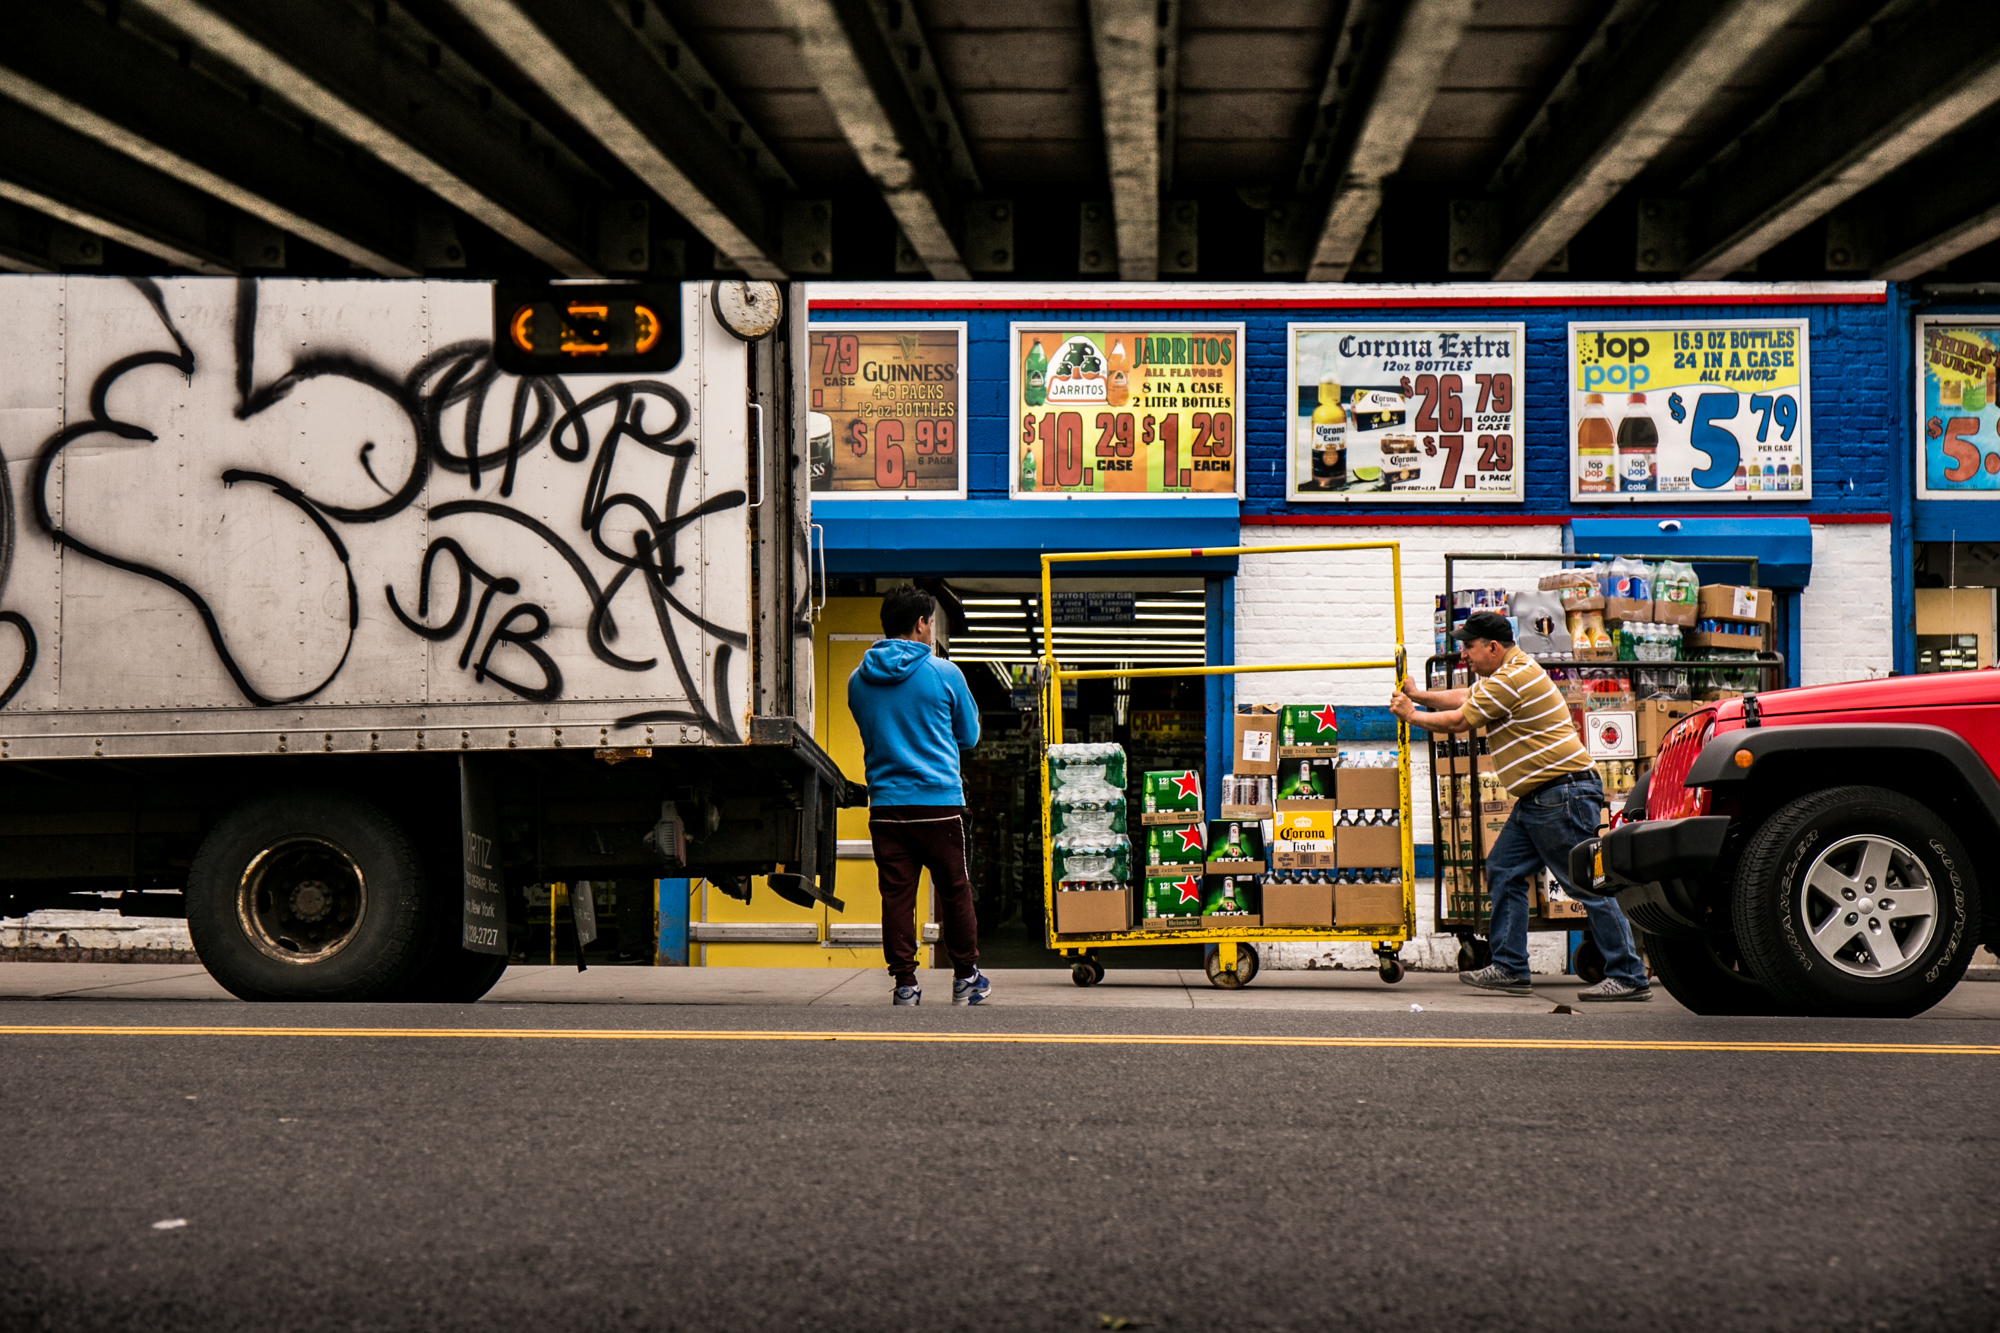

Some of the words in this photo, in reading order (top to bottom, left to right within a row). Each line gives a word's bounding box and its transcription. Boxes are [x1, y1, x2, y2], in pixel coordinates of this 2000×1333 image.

[1339, 335, 1432, 358] Corona
[1439, 333, 1510, 358] Extra
[1674, 332, 1703, 350] 16.9
[1708, 332, 1725, 349] OZ
[1730, 330, 1794, 349] BOTTLES
[1133, 338, 1232, 368] JARRITOS
[1595, 332, 1649, 363] top
[1415, 360, 1473, 371] BOTTLES
[1674, 352, 1696, 368] 24
[1704, 352, 1722, 368] IN
[1730, 352, 1741, 367] A
[1747, 351, 1794, 367] CASE
[1930, 349, 1986, 379] BURST
[862, 362, 954, 382] GUINNESS
[1144, 368, 1166, 377] ALL
[1170, 368, 1223, 377] FLAVORS
[1584, 364, 1650, 391] pop
[1700, 370, 1720, 381] ALL
[1725, 369, 1777, 381] FLAVORS
[824, 378, 855, 386] CASE
[1142, 382, 1151, 393] 8
[1157, 382, 1170, 393] IN
[1176, 382, 1185, 393] A
[1191, 382, 1223, 393] CASE
[872, 384, 896, 400] 4-6
[900, 384, 944, 400] PACKS
[1052, 384, 1104, 395] JARRITOS
[1133, 397, 1140, 407] 2
[1145, 397, 1177, 408] LITER
[1182, 397, 1230, 408] BOTTLES
[858, 402, 873, 418] 12
[878, 406, 890, 417] oz
[896, 402, 954, 418] BOTTLES
[1316, 426, 1345, 436] Corona
[918, 457, 924, 465] 6
[928, 456, 953, 465] PACK
[1096, 460, 1132, 471] CASE
[1194, 461, 1230, 472] EACH
[1390, 456, 1418, 465] Corona
[1589, 461, 1602, 470] top
[1631, 459, 1646, 468] top
[1585, 470, 1602, 478] pop
[1628, 468, 1646, 477] pop
[1628, 482, 1646, 491] cola
[1133, 713, 1175, 731] CRAFT
[1280, 827, 1325, 842] Corona
[466, 831, 492, 870] ORTIZ
[1780, 830, 1818, 970] WRANGLER
[481, 902, 495, 917] York
[1925, 838, 1965, 982] GOODYEAR
